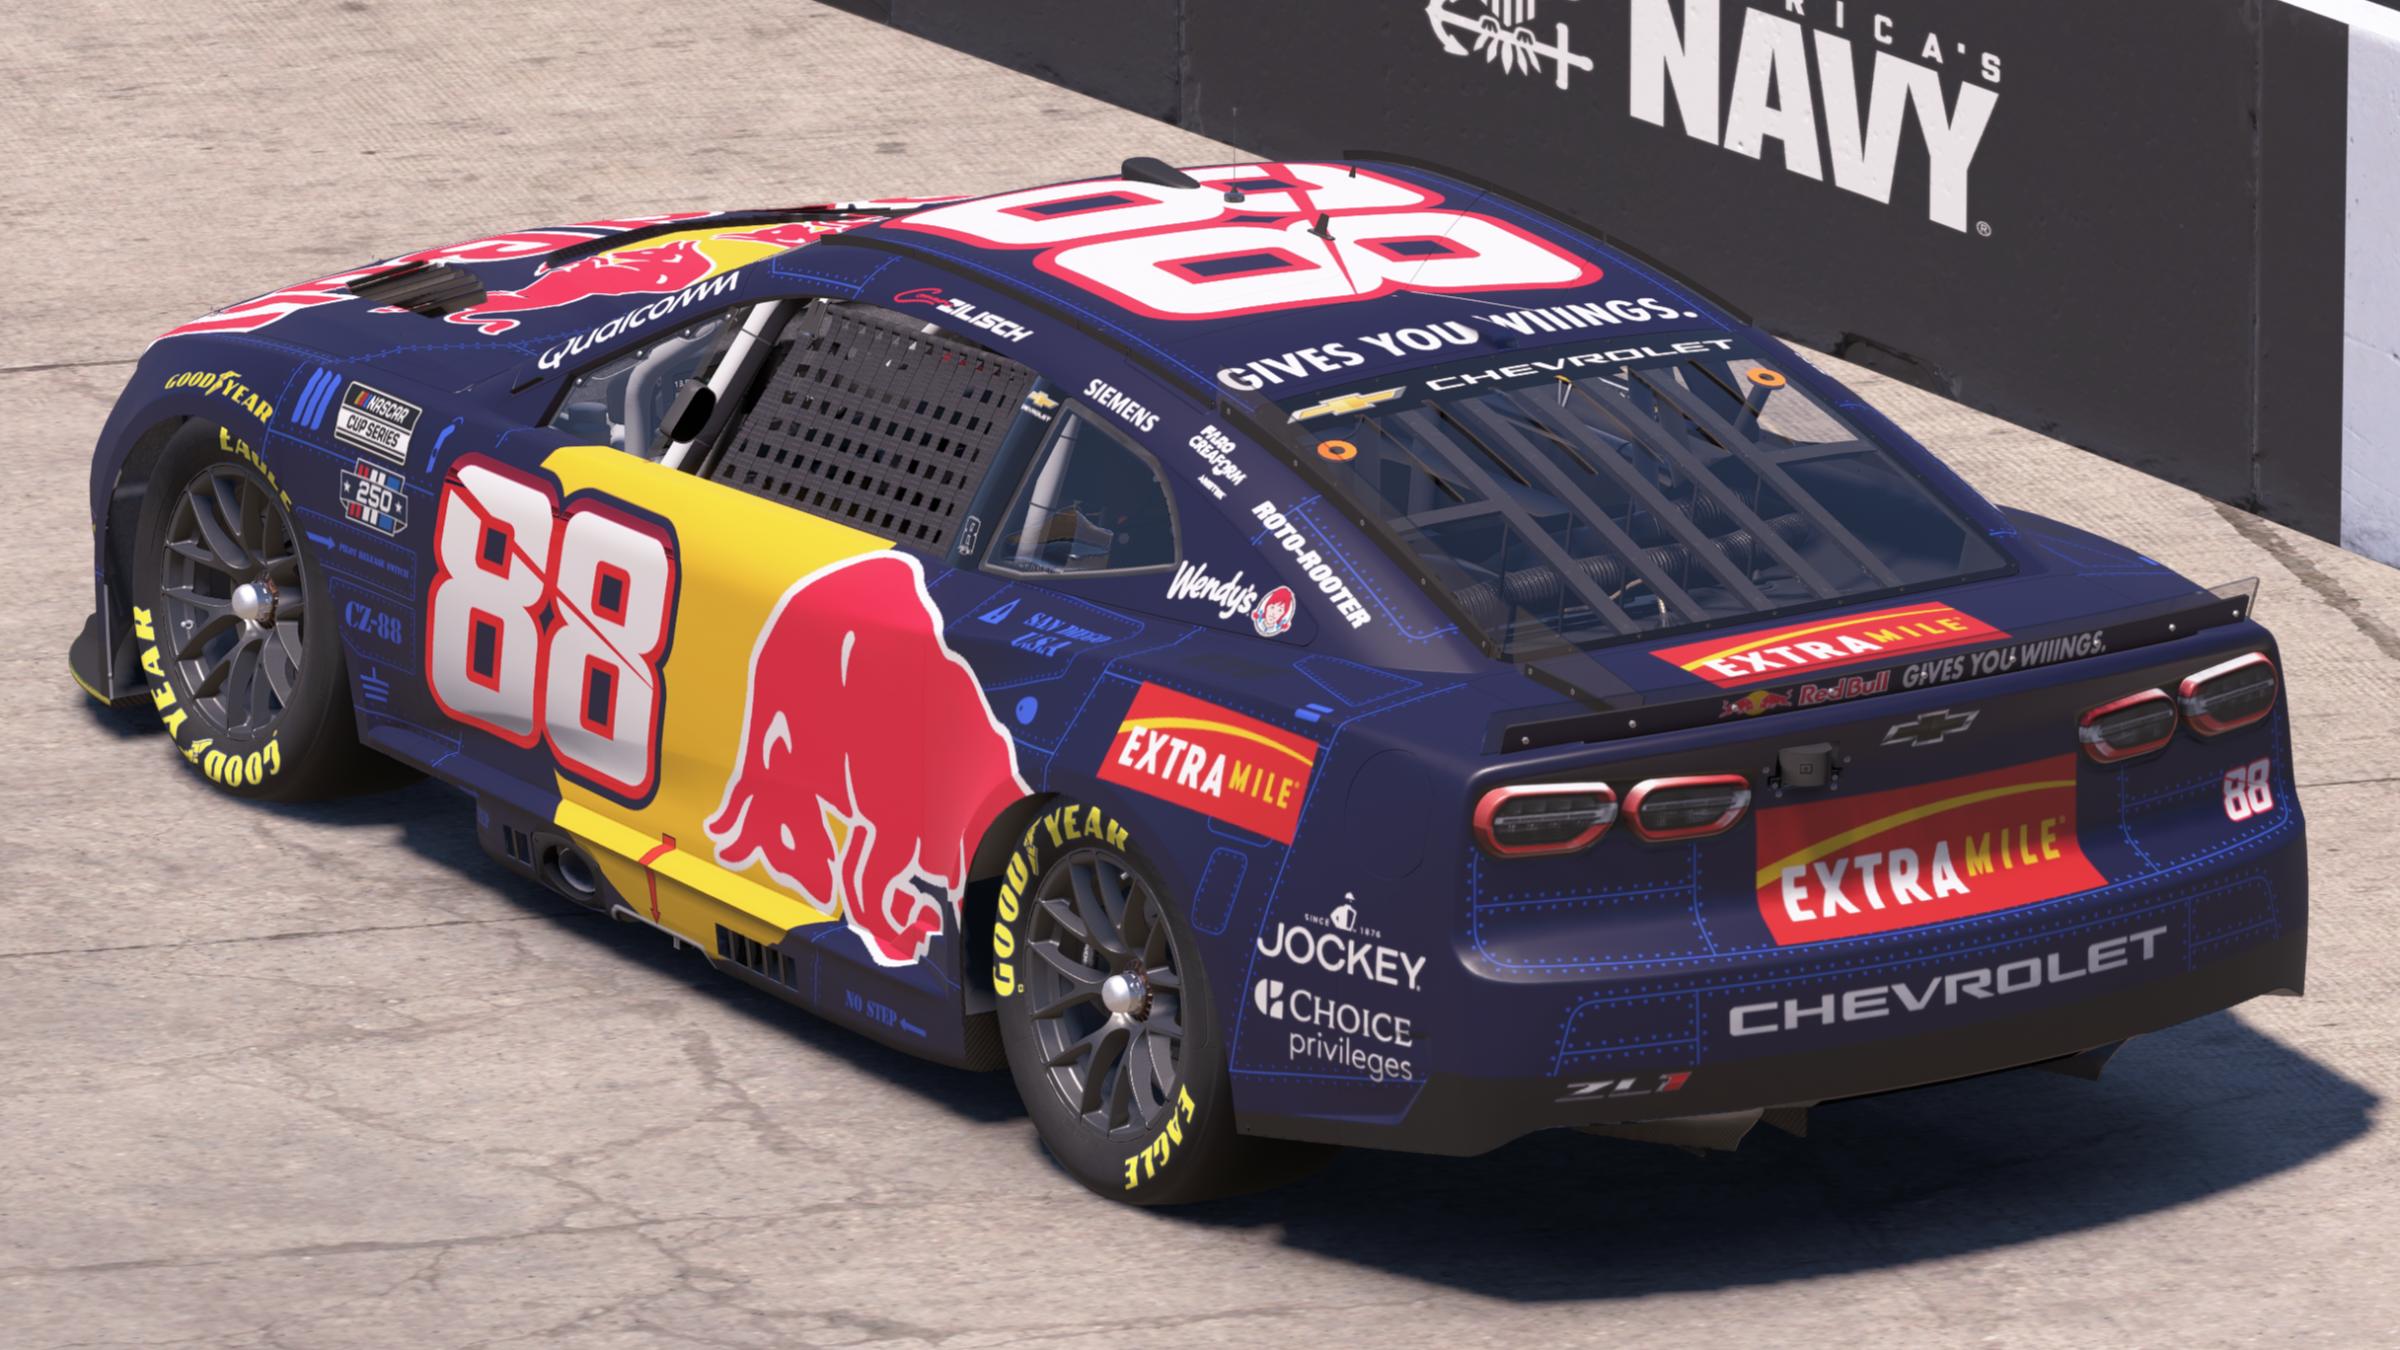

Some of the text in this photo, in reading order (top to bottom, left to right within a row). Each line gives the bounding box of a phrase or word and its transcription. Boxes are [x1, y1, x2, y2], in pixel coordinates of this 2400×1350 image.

[1630, 0, 1999, 233] NAVY
[880, 160, 1604, 320] 88
[936, 298, 1034, 342] ZILISCH
[1216, 343, 1365, 392] GIVES
[1359, 321, 1479, 357] YOU
[1426, 338, 1734, 391] CHEVROLET
[346, 414, 400, 447] CUP SERIES
[366, 396, 410, 424] NASCAR
[1083, 378, 1160, 432] SIEMENS
[1188, 435, 1247, 486] CREAFORM
[1200, 424, 1237, 454] FARO
[356, 480, 393, 513] 250
[1166, 560, 1258, 620] Wendy's
[1251, 500, 1371, 630] ROTO-ROOTER
[345, 600, 402, 645] CZ-88
[425, 452, 677, 800] 88
[1798, 681, 1846, 706] Red
[1846, 670, 1891, 696] Bull
[1903, 656, 1965, 688] GIVES
[1970, 646, 2016, 675] YOU
[2223, 756, 2274, 823] 88
[1304, 913, 1381, 939] SINCE 1876
[1257, 922, 1426, 990] JOCKEY
[1729, 925, 2167, 1037] CHEVROLET
[845, 989, 897, 1026] NO STEP
[1290, 989, 1413, 1047] CHOICE
[1290, 1032, 1412, 1082] privileges
[1125, 1084, 1195, 1191] EAGLE
